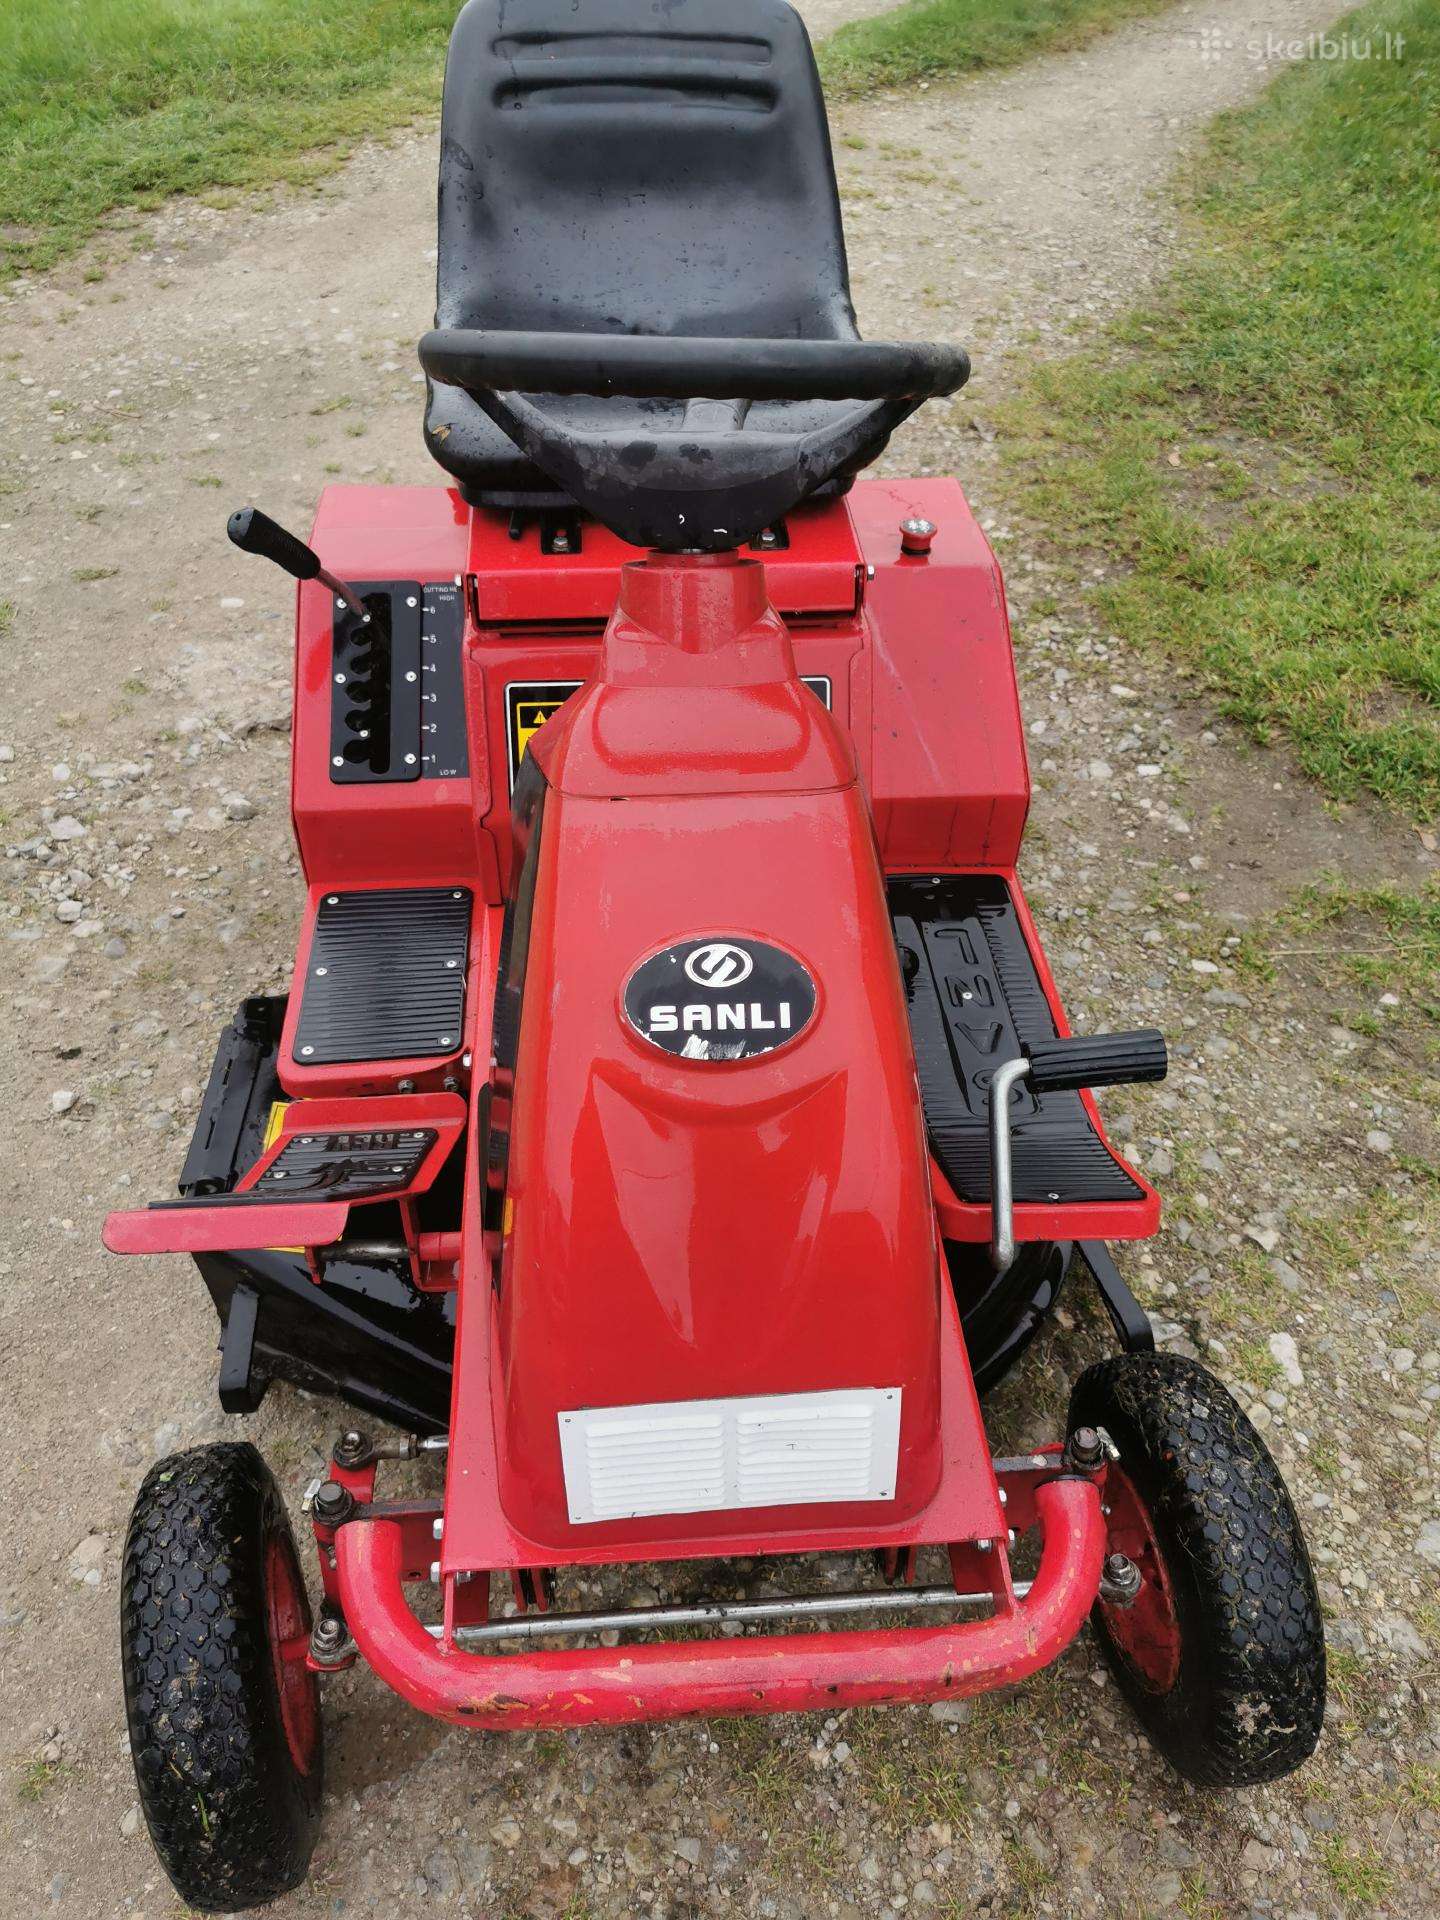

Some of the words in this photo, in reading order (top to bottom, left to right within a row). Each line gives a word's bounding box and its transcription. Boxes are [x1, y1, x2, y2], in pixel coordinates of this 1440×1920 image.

[429, 606, 436, 615] 6
[429, 634, 437, 644] 5
[429, 663, 437, 673] 4
[429, 693, 437, 703] 3
[429, 722, 437, 733] 2
[430, 752, 436, 763] 1
[649, 1002, 791, 1032] SANLI
